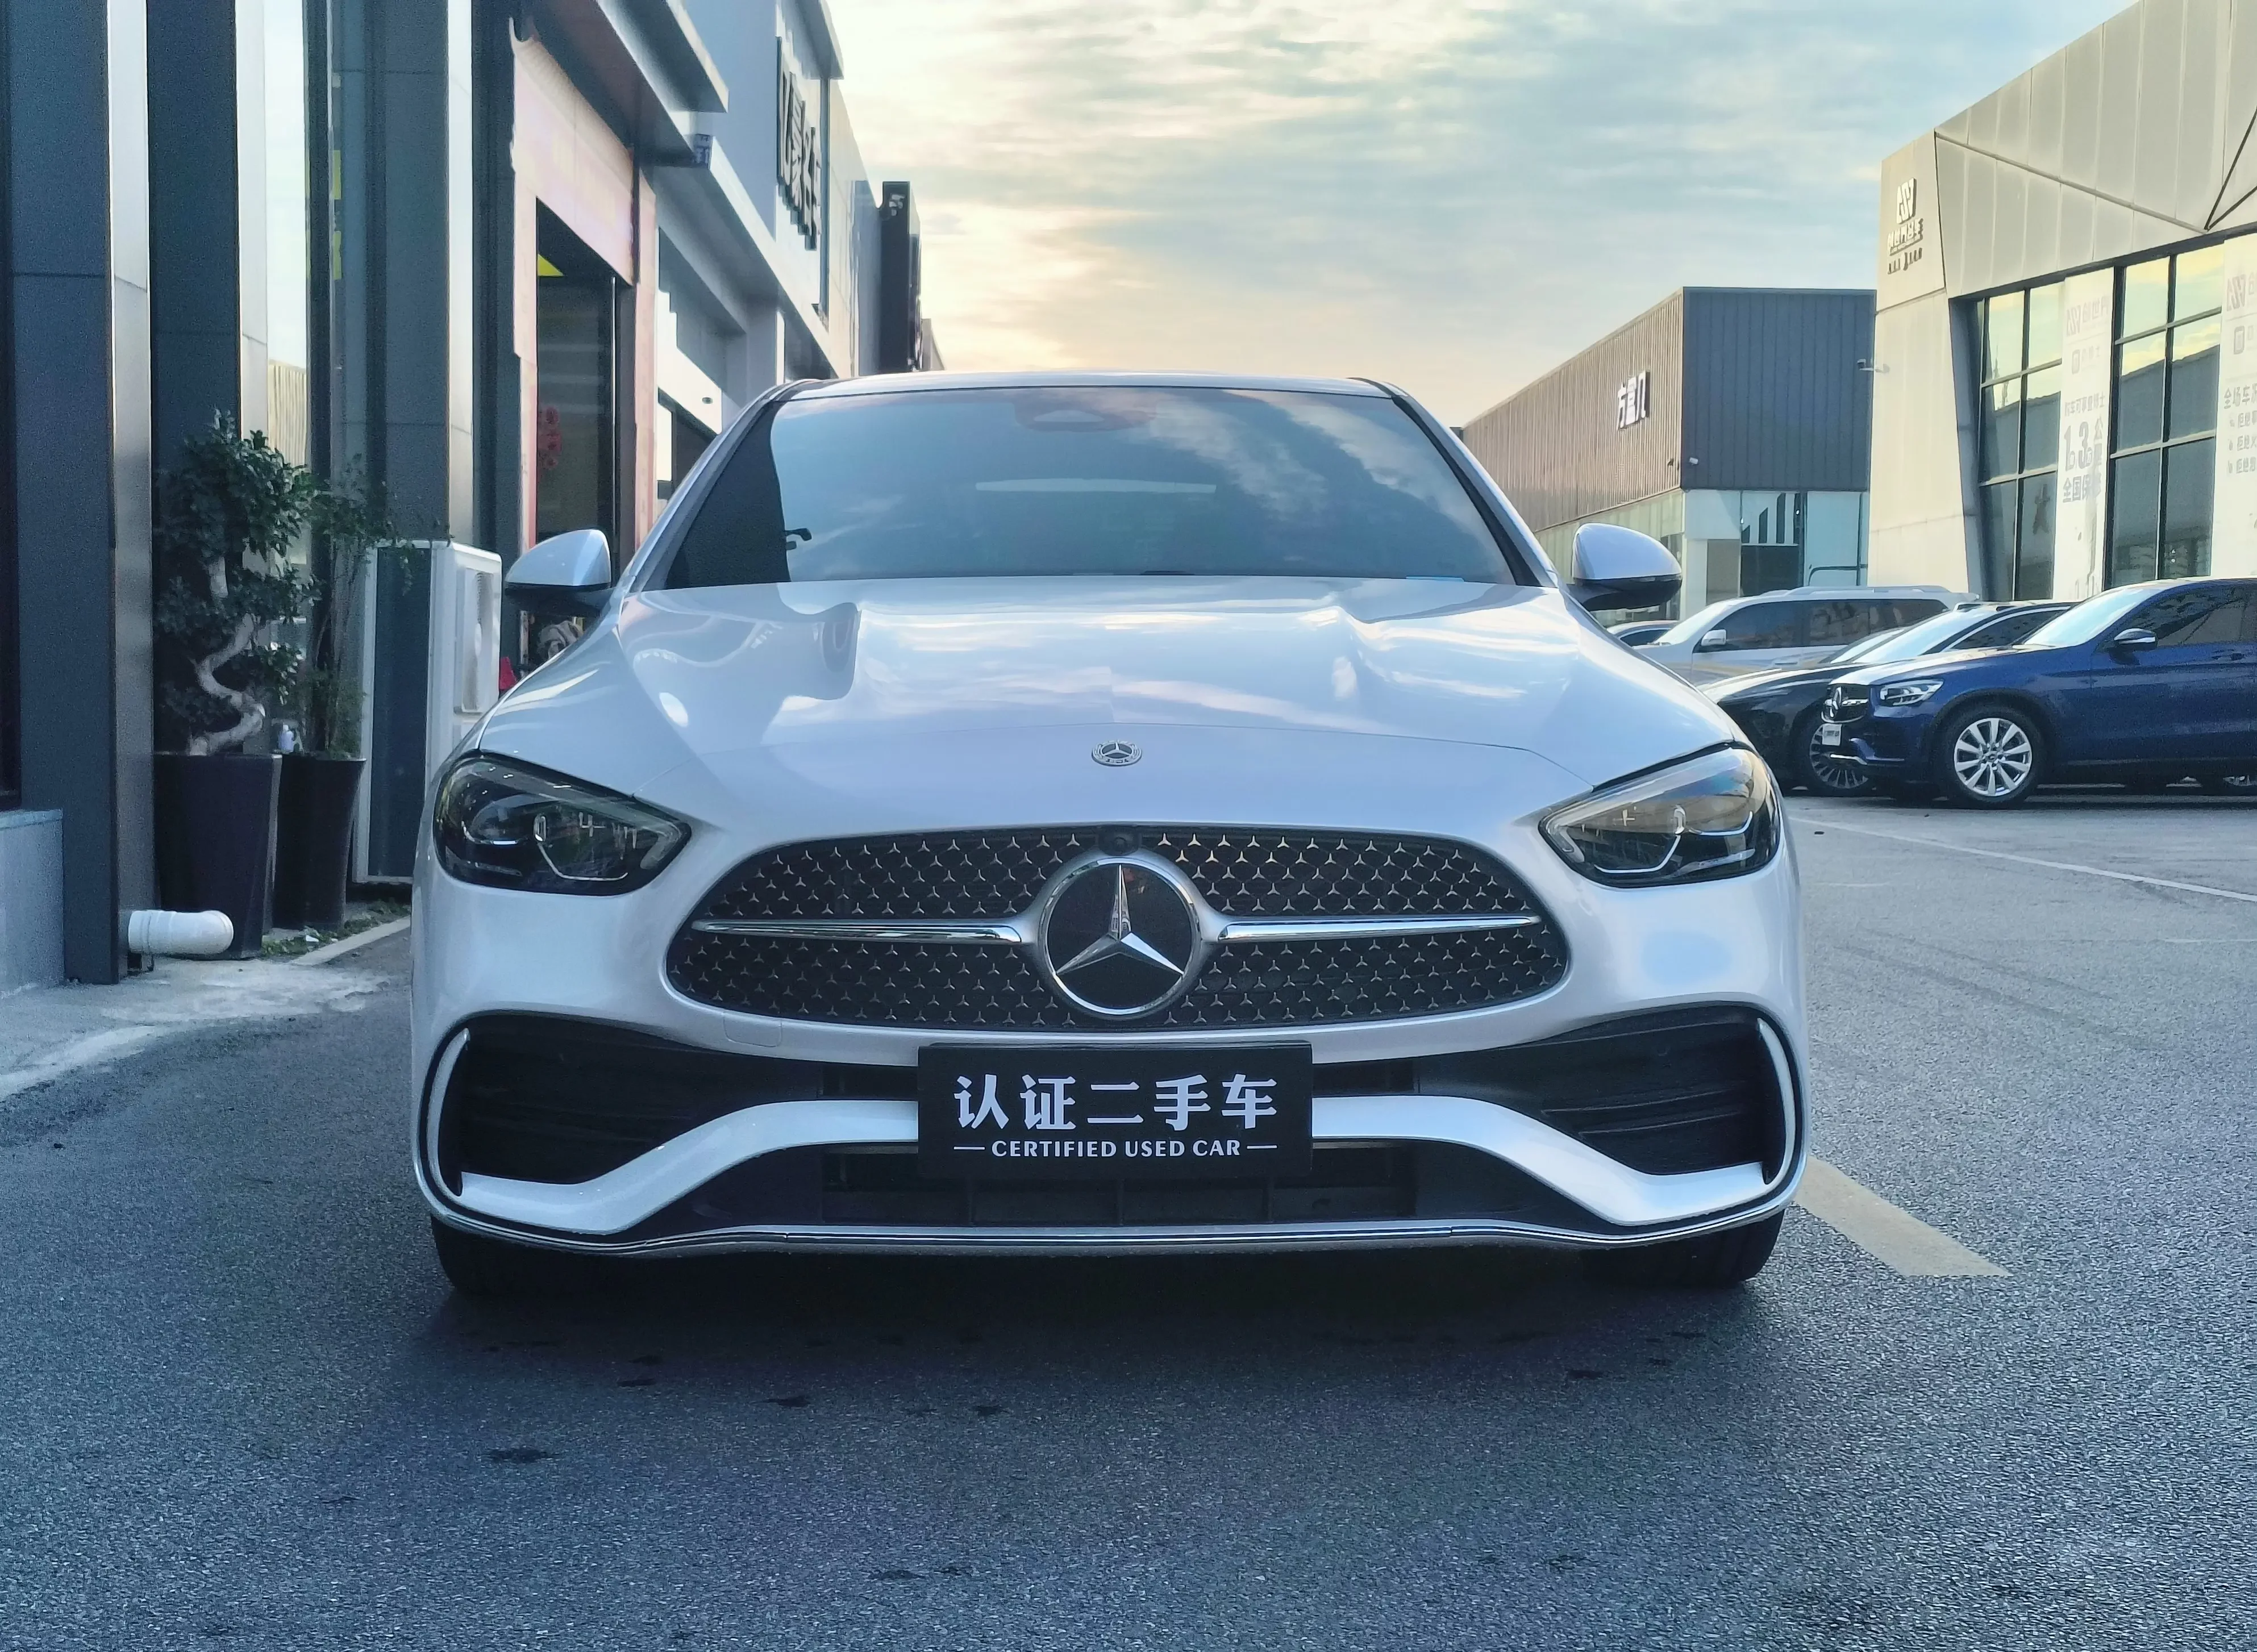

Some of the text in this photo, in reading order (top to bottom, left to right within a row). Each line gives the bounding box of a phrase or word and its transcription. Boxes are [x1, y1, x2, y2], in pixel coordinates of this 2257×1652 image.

[953, 1074, 1277, 1131] 认证二手车
[992, 1140, 1240, 1157] CERTIFIED USED CAR
